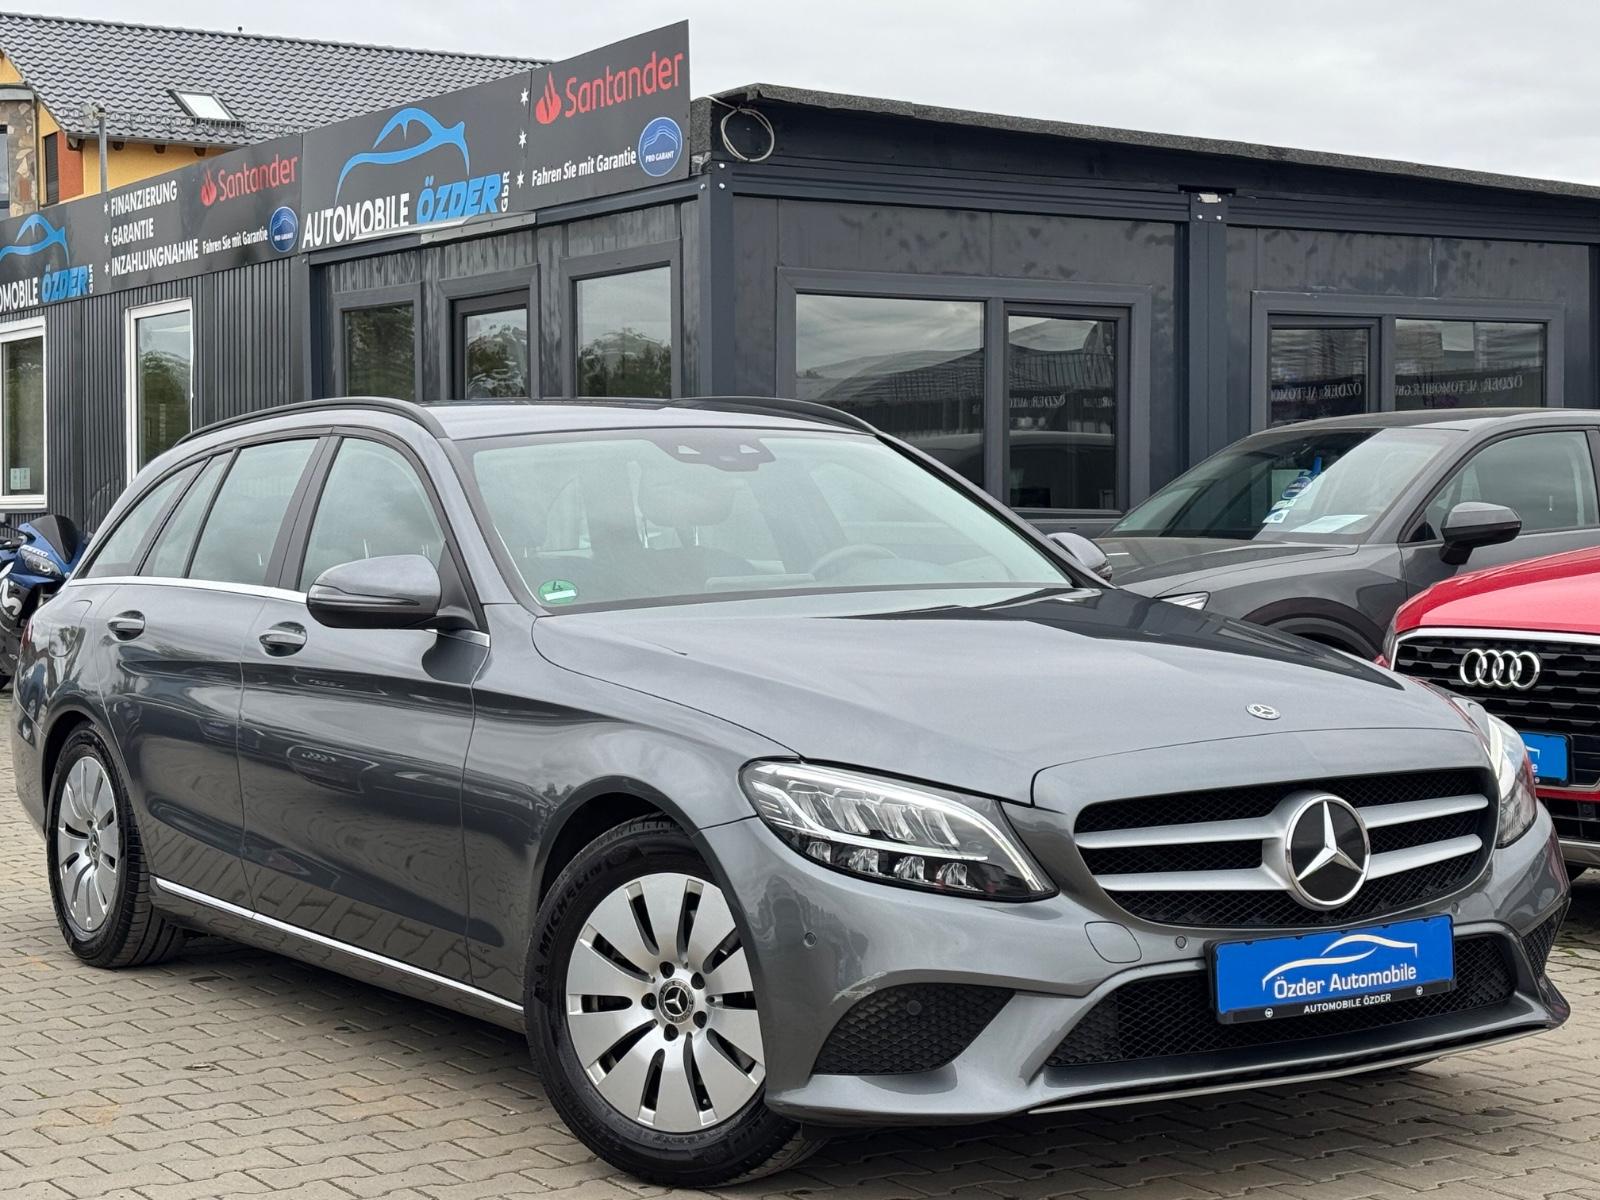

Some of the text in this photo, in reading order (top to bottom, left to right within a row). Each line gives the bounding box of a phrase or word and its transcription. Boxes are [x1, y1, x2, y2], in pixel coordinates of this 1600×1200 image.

[564, 51, 684, 118] Santander
[218, 154, 299, 202] Santander
[532, 147, 637, 187] Fahren Sie mit Garantie
[111, 180, 178, 217] FINANZIERUNG
[302, 174, 501, 249] AUTOMOBILE ÖZDER
[501, 171, 510, 213] GbR
[111, 218, 154, 247] GARANTIE
[202, 239, 222, 255] Fahren
[222, 235, 231, 250] Sie
[232, 232, 242, 248] mit
[242, 226, 268, 246] Garantie
[111, 238, 199, 277] INZAHLUNGNAHME
[41, 264, 88, 303] ÖZDER
[1274, 964, 1417, 999] Özder Automobile
[1303, 993, 1392, 1014] AUTOMOBILE ÖZDER
